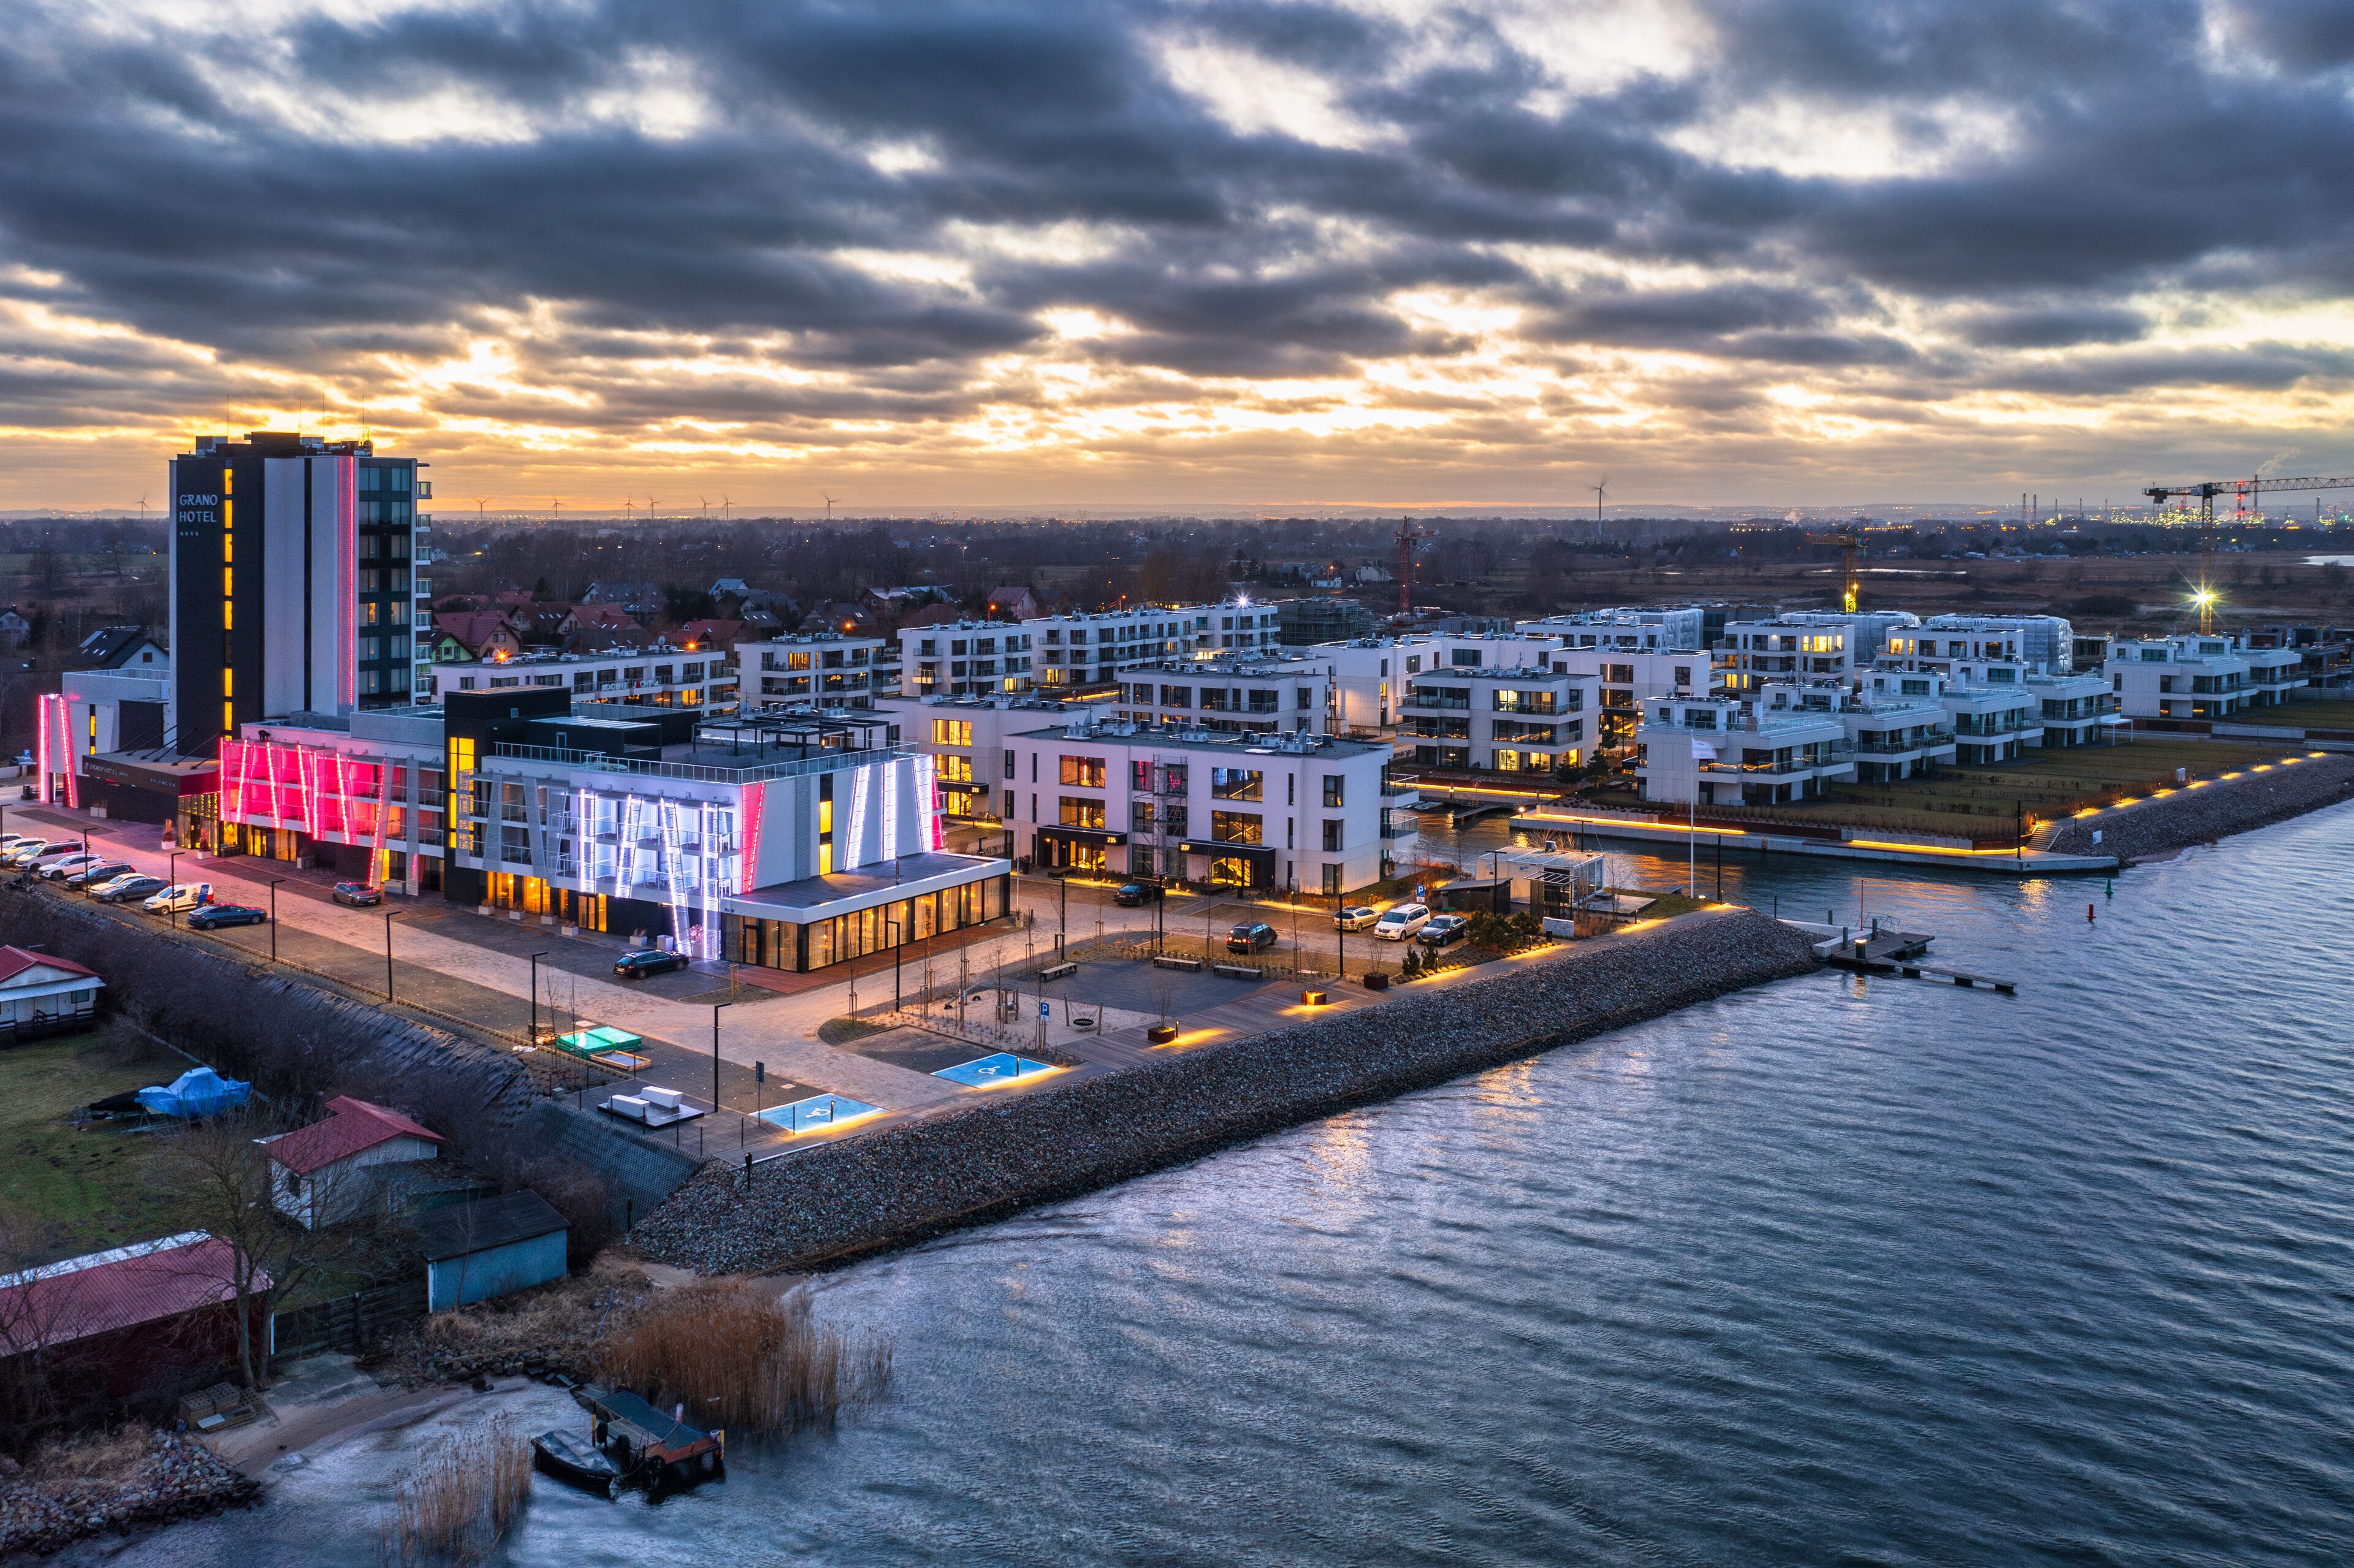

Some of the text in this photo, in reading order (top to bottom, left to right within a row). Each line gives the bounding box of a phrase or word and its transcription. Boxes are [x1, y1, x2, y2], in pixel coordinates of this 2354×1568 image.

[180, 494, 218, 506] GRANO
[180, 511, 217, 522] HOTEL
[1042, 1004, 1048, 1013] P
